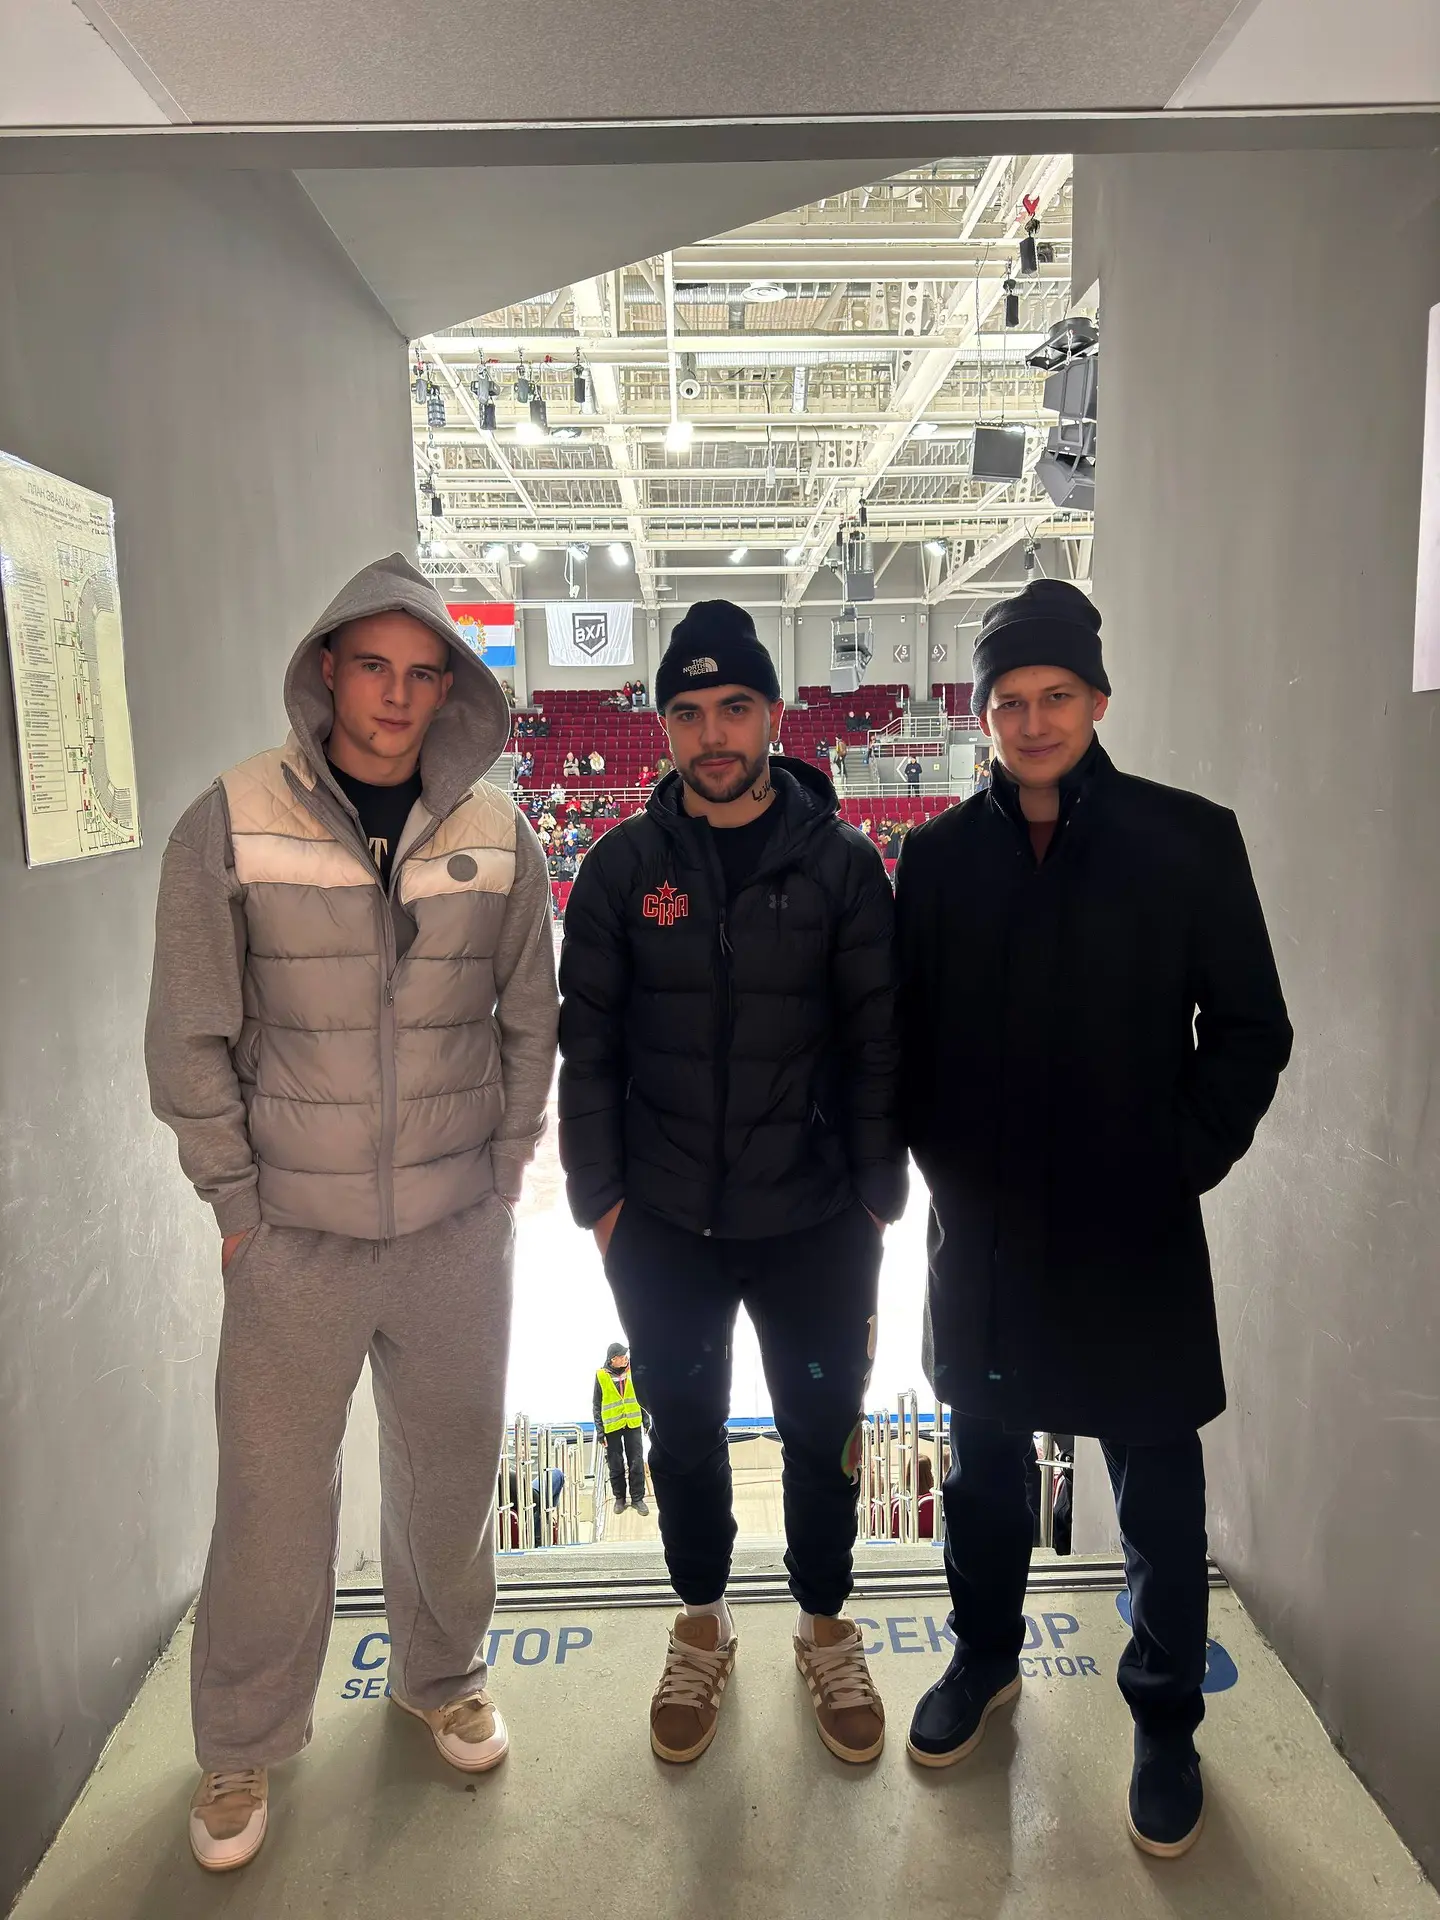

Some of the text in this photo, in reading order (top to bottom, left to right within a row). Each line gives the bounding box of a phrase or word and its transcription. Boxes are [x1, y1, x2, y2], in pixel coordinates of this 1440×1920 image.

[575, 622, 606, 643] ВХЛ
[901, 645, 907, 655] 5
[933, 645, 939, 654] 6
[692, 657, 705, 666] THE
[683, 662, 705, 674] NORTH
[689, 668, 706, 677] FACE
[856, 1612, 1081, 1655] СЕКОР
[351, 1626, 593, 1671] СТОР
[1019, 1655, 1102, 1679] CTOR
